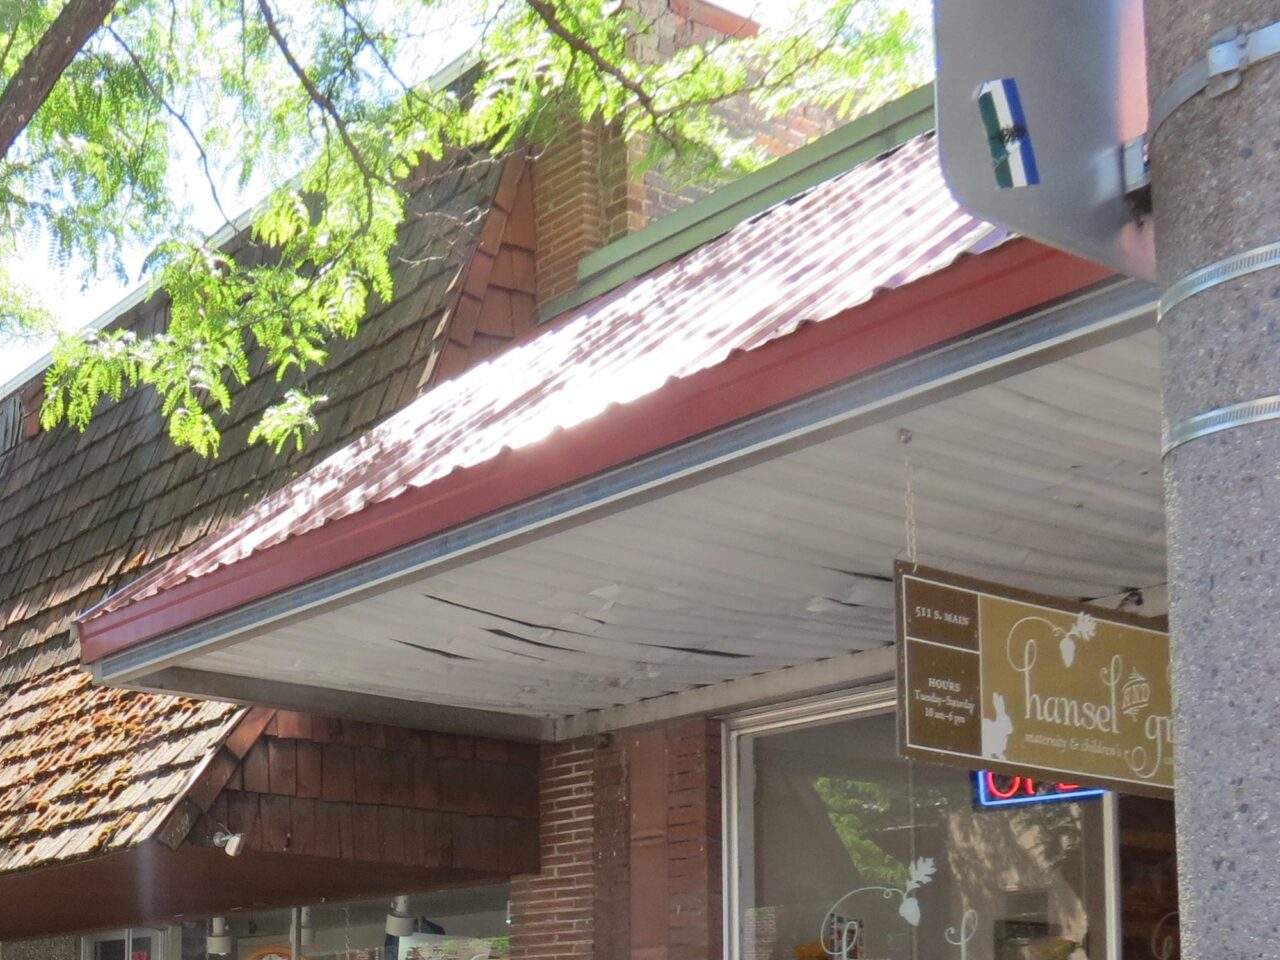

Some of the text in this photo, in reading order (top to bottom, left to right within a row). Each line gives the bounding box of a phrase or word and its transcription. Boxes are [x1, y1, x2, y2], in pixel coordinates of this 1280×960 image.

[915, 606, 932, 618] 511
[944, 612, 969, 626] MAIN
[928, 677, 961, 692] HOURS
[1009, 628, 1122, 734] hansel
[1024, 733, 1067, 752] maternity
[1069, 738, 1080, 751] &
